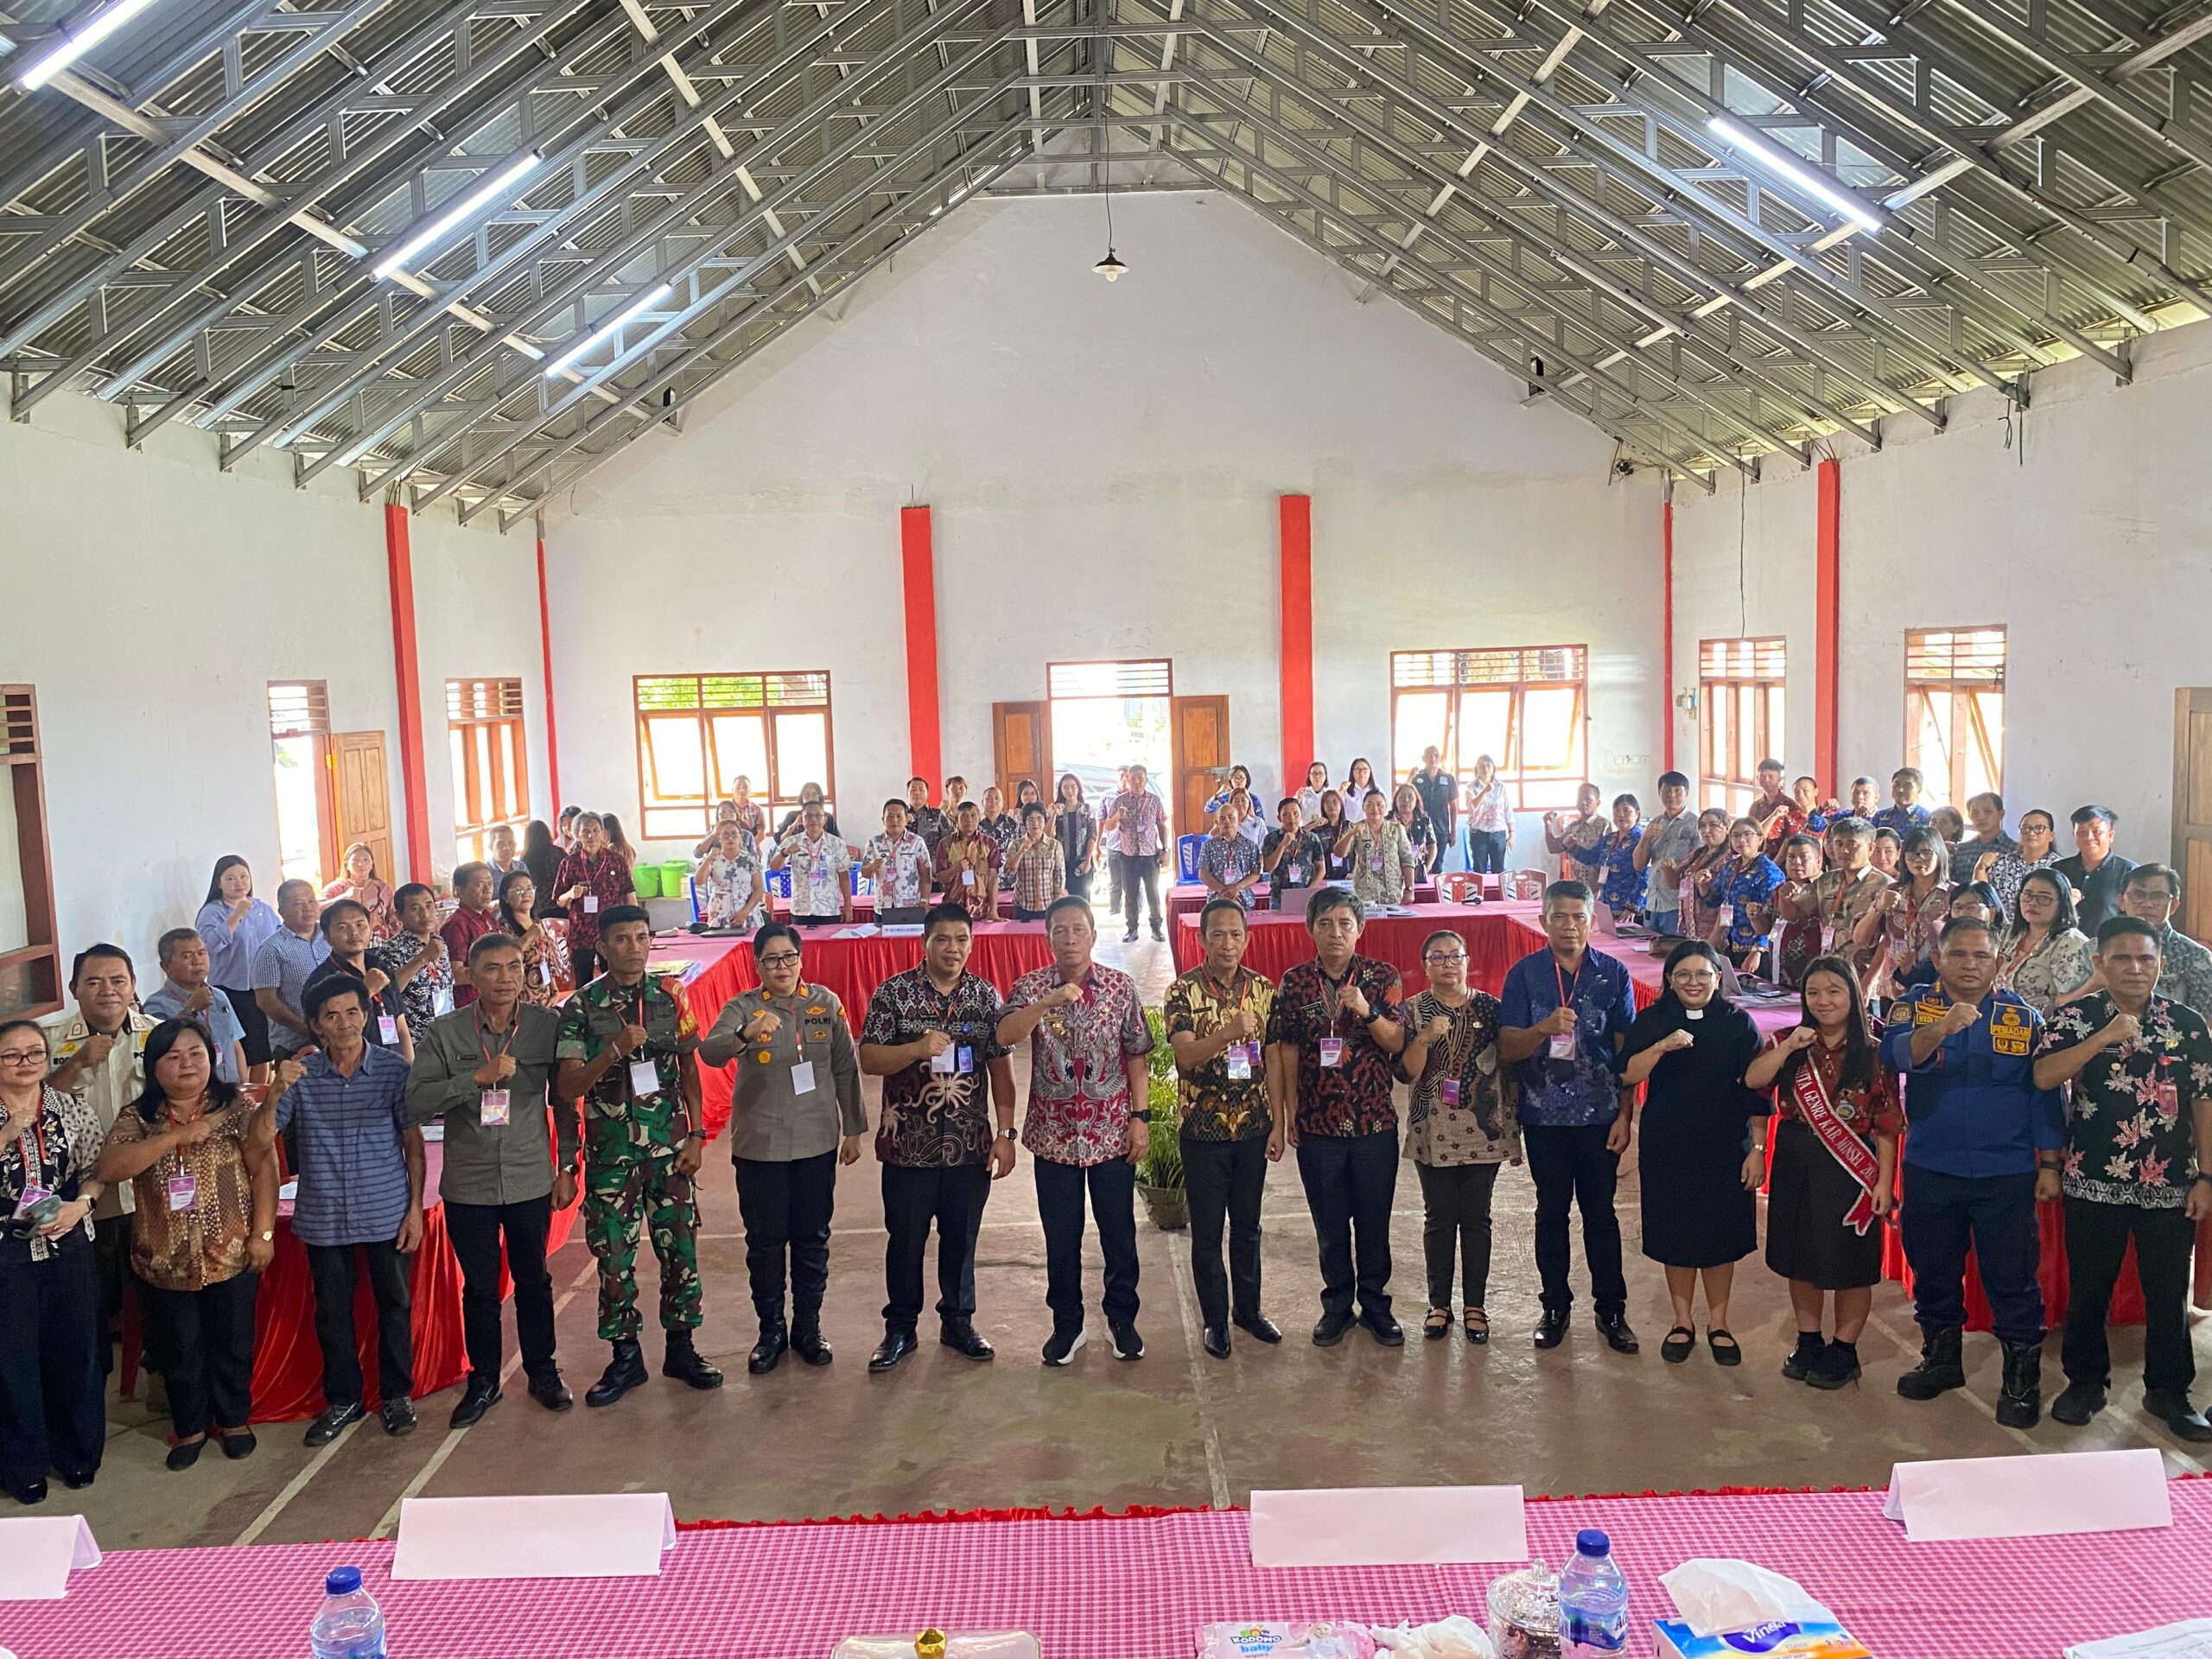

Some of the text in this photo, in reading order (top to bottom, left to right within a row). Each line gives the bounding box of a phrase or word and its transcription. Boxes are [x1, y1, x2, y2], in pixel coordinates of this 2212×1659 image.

[1803, 1090, 1827, 1120] GENRE
[1818, 1119, 1843, 1142] KAB.
[1835, 1136, 1866, 1168] MINSEL
[1230, 1636, 1281, 1644] KODOMO
[1240, 1644, 1273, 1653] baby
